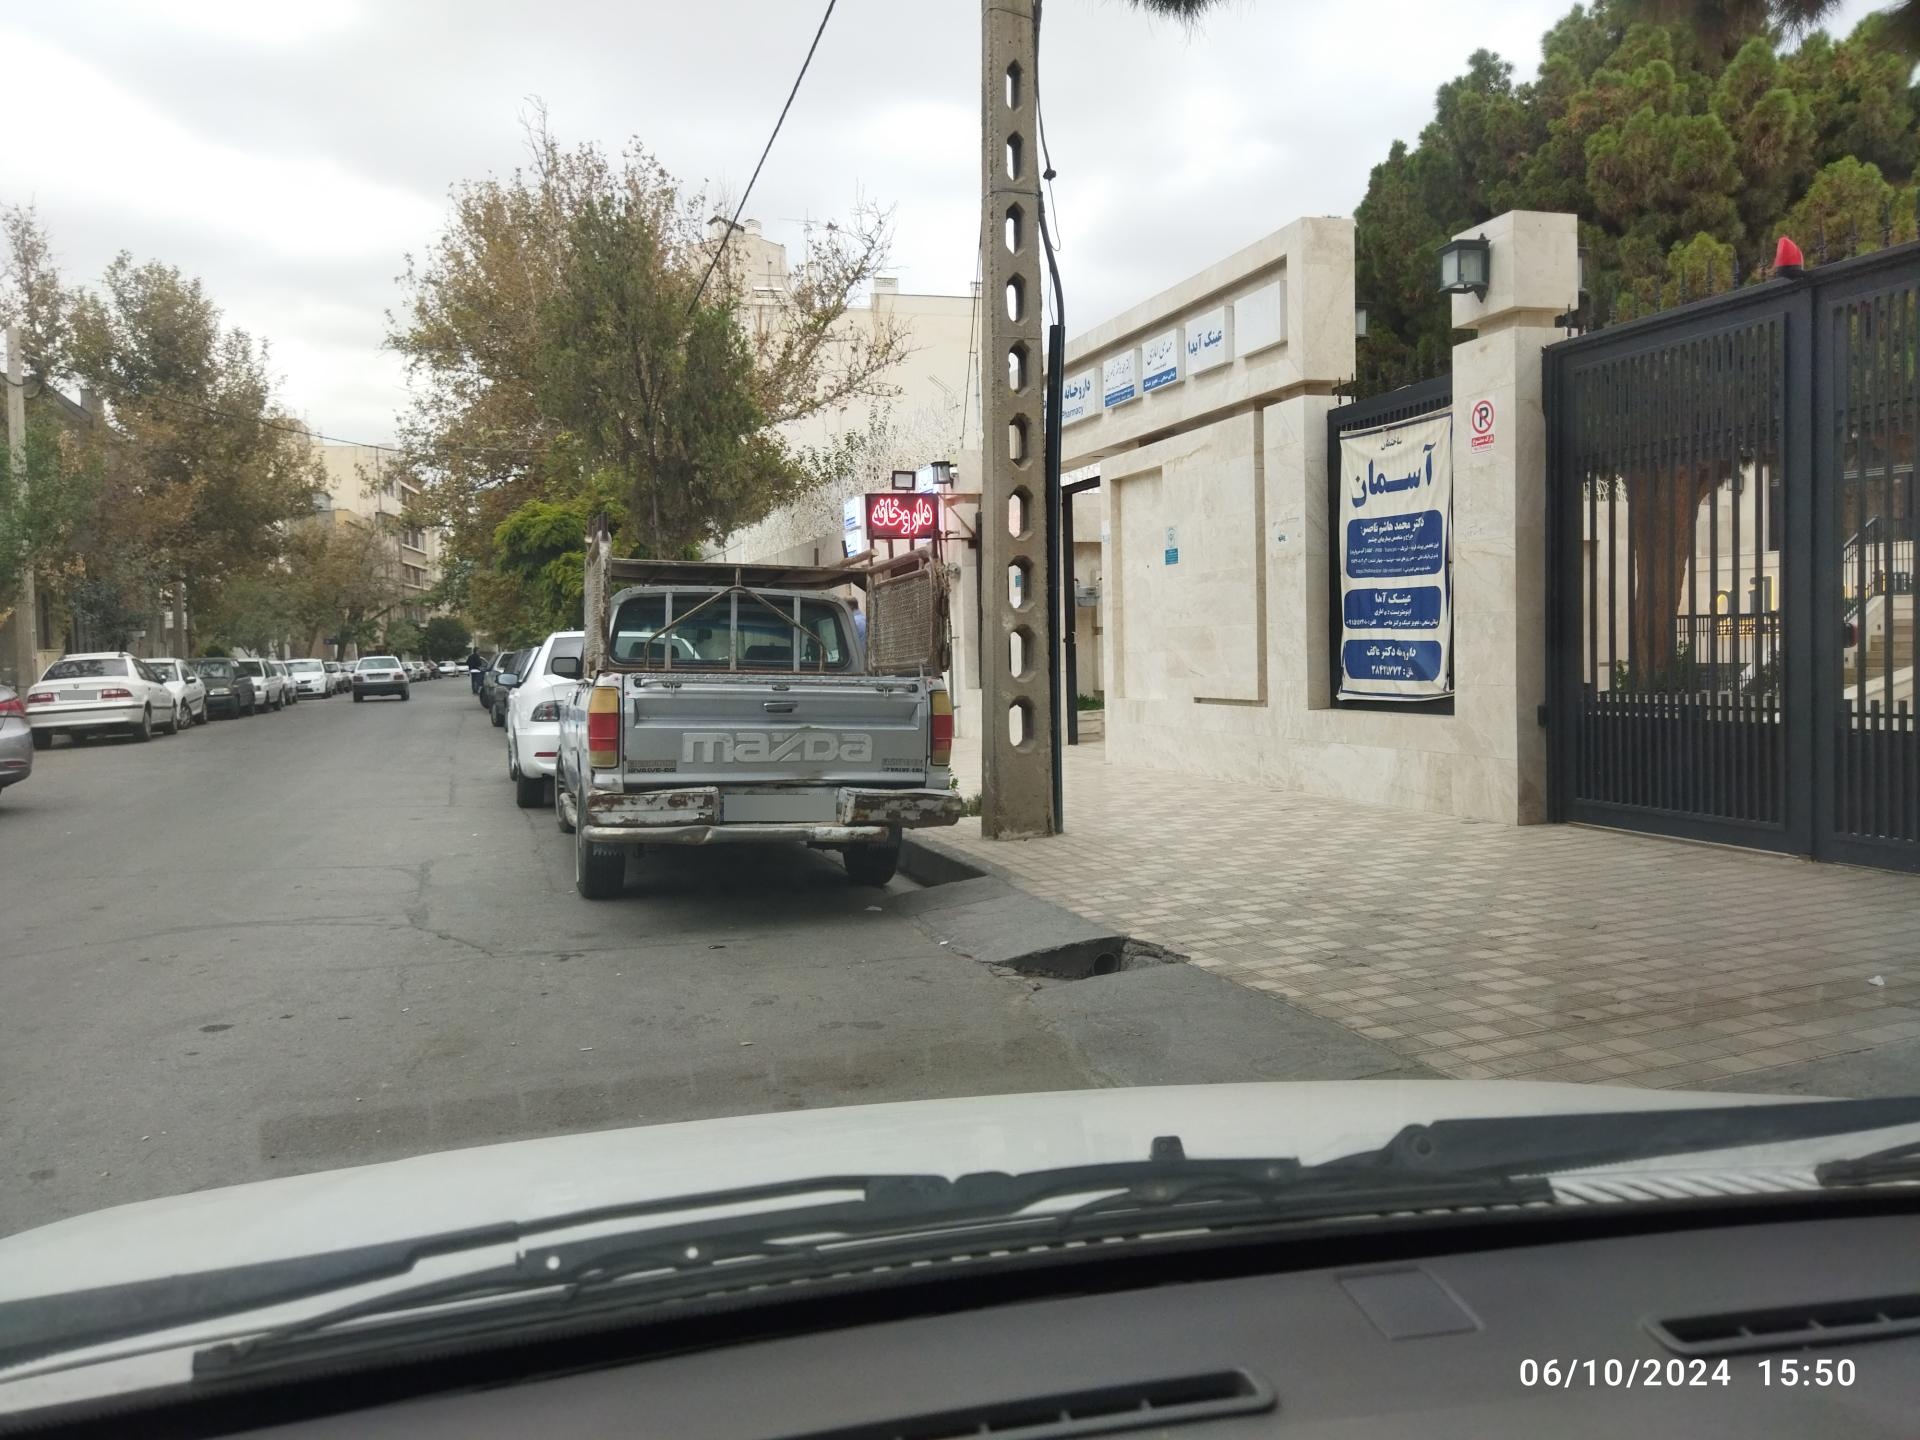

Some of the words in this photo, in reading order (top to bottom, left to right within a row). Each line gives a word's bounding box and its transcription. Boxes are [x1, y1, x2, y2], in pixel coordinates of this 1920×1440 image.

[1064, 377, 1091, 400] داروخانه
[1351, 441, 1437, 509] آسمان
[872, 498, 933, 535] داروخانه
